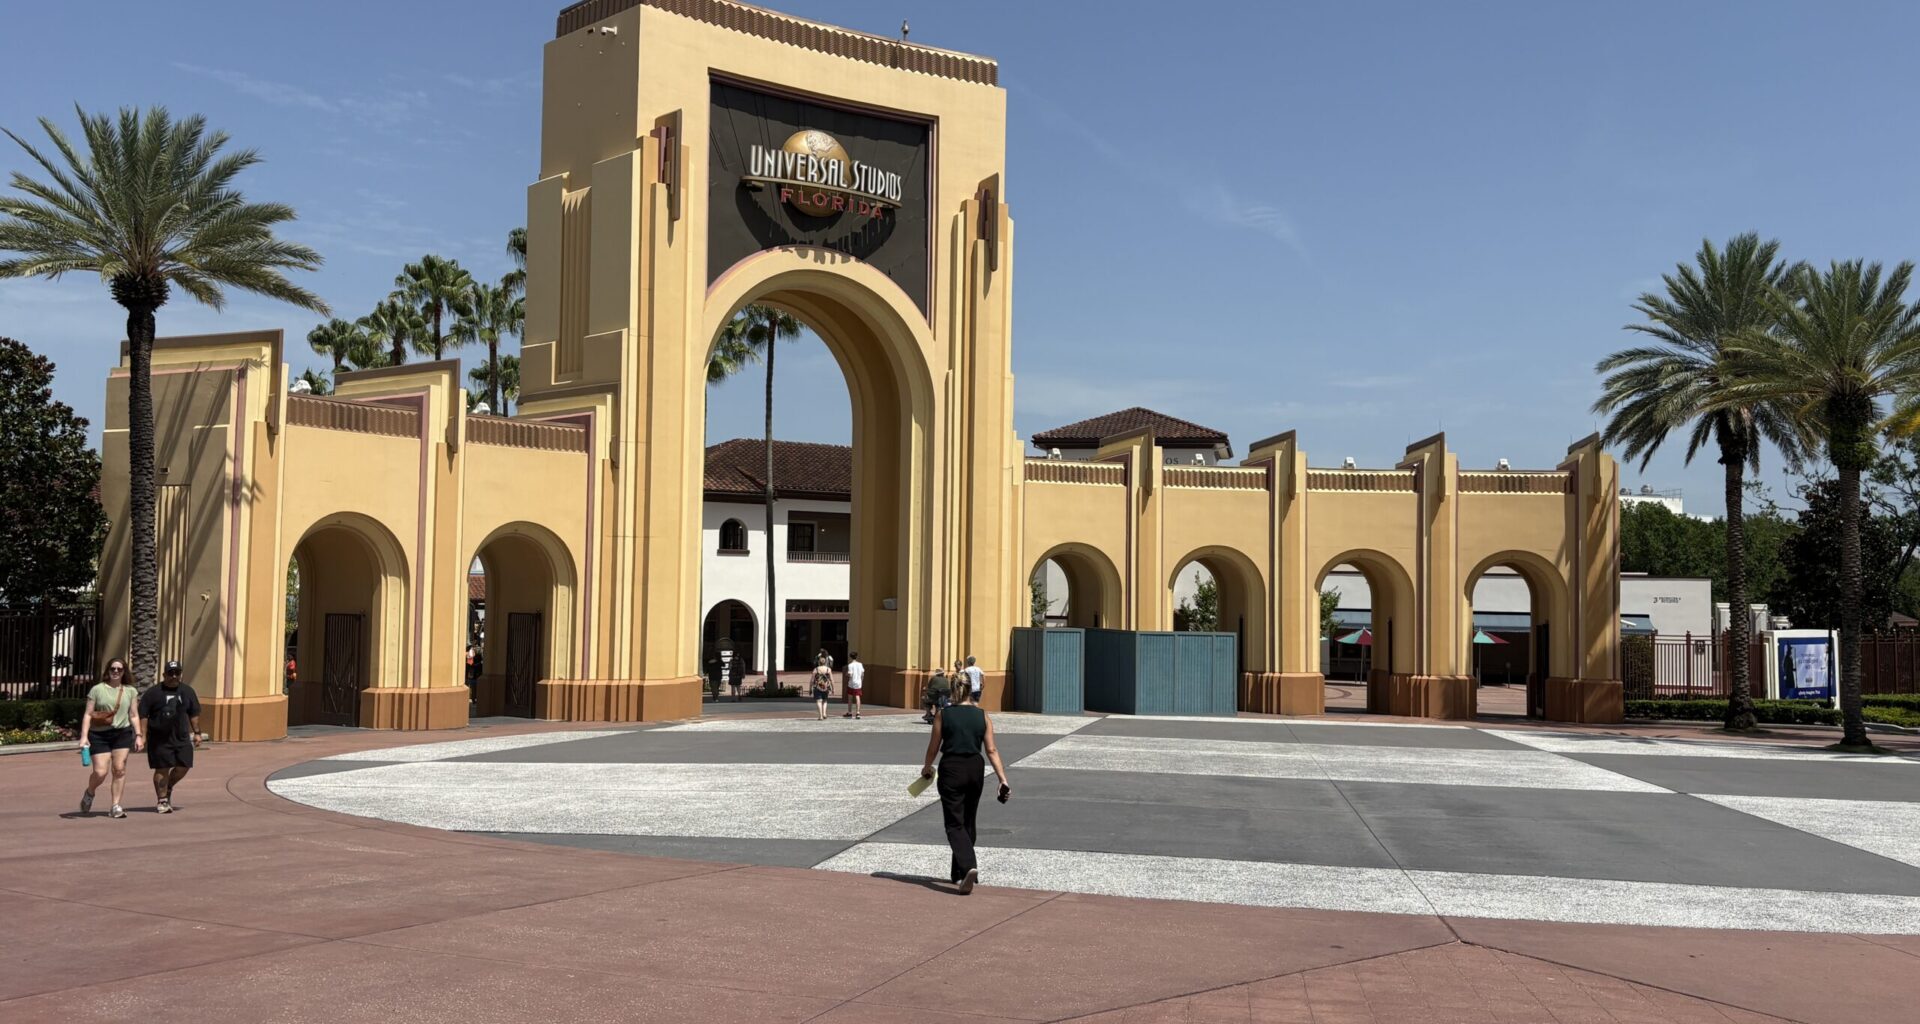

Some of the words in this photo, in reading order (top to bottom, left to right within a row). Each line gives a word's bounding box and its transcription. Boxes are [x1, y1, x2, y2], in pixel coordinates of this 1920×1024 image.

[750, 145, 848, 188] UNIVERSAL
[853, 160, 902, 201] STUDIOS
[780, 188, 883, 220] FLORIDA
